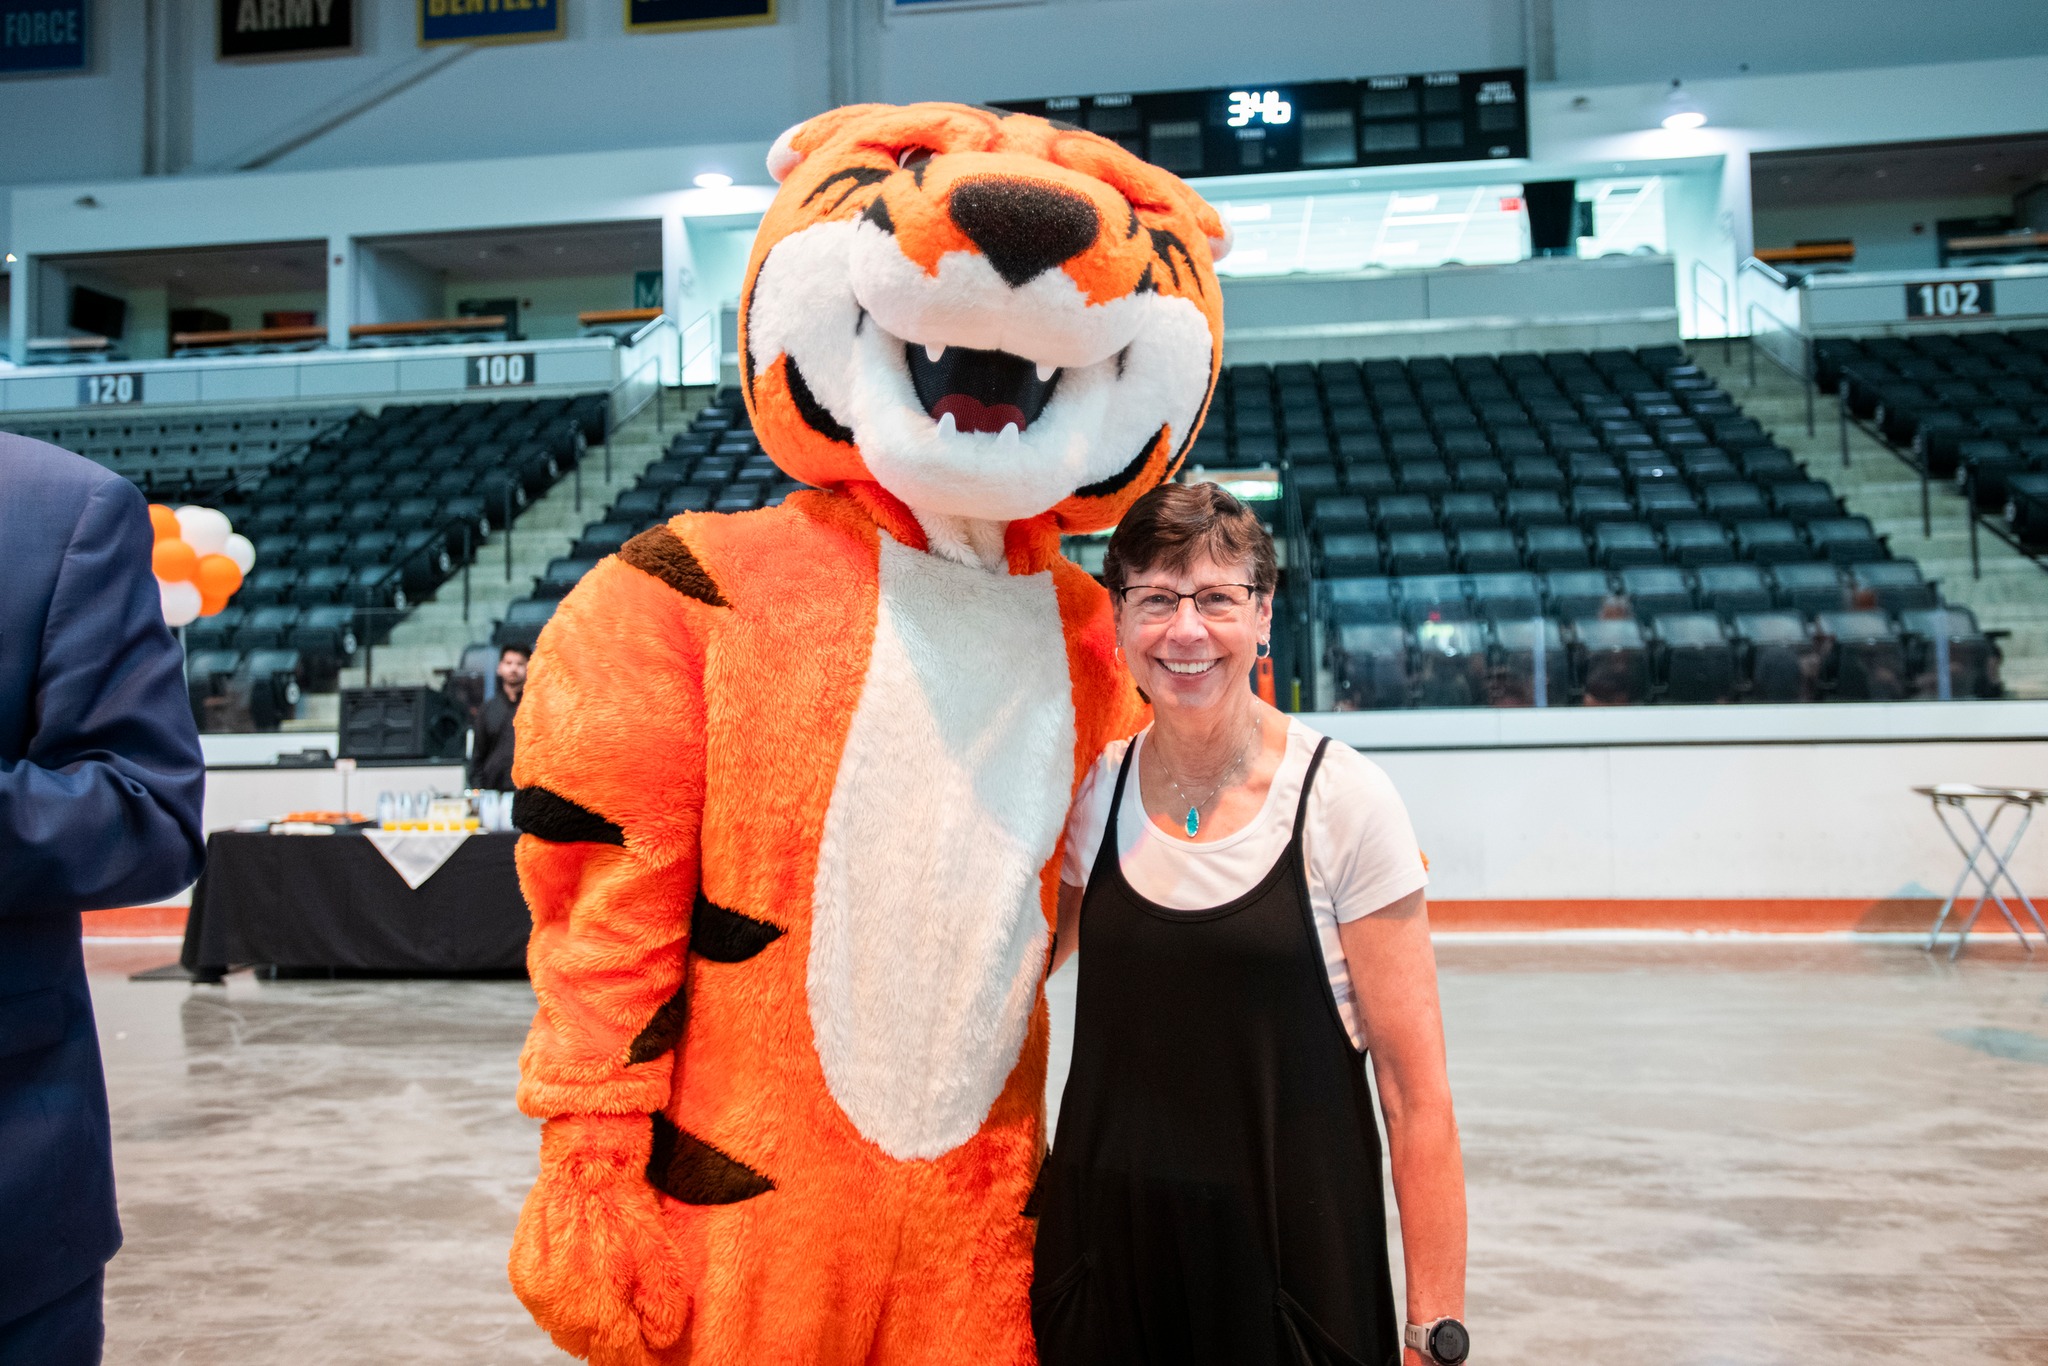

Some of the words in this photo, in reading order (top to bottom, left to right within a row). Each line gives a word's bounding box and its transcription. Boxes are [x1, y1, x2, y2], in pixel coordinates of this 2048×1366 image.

[6, 10, 77, 46] FORCE
[236, 0, 332, 32] ARMY
[1919, 282, 1980, 316] 102
[476, 354, 525, 386] 100
[88, 374, 133, 404] 120
